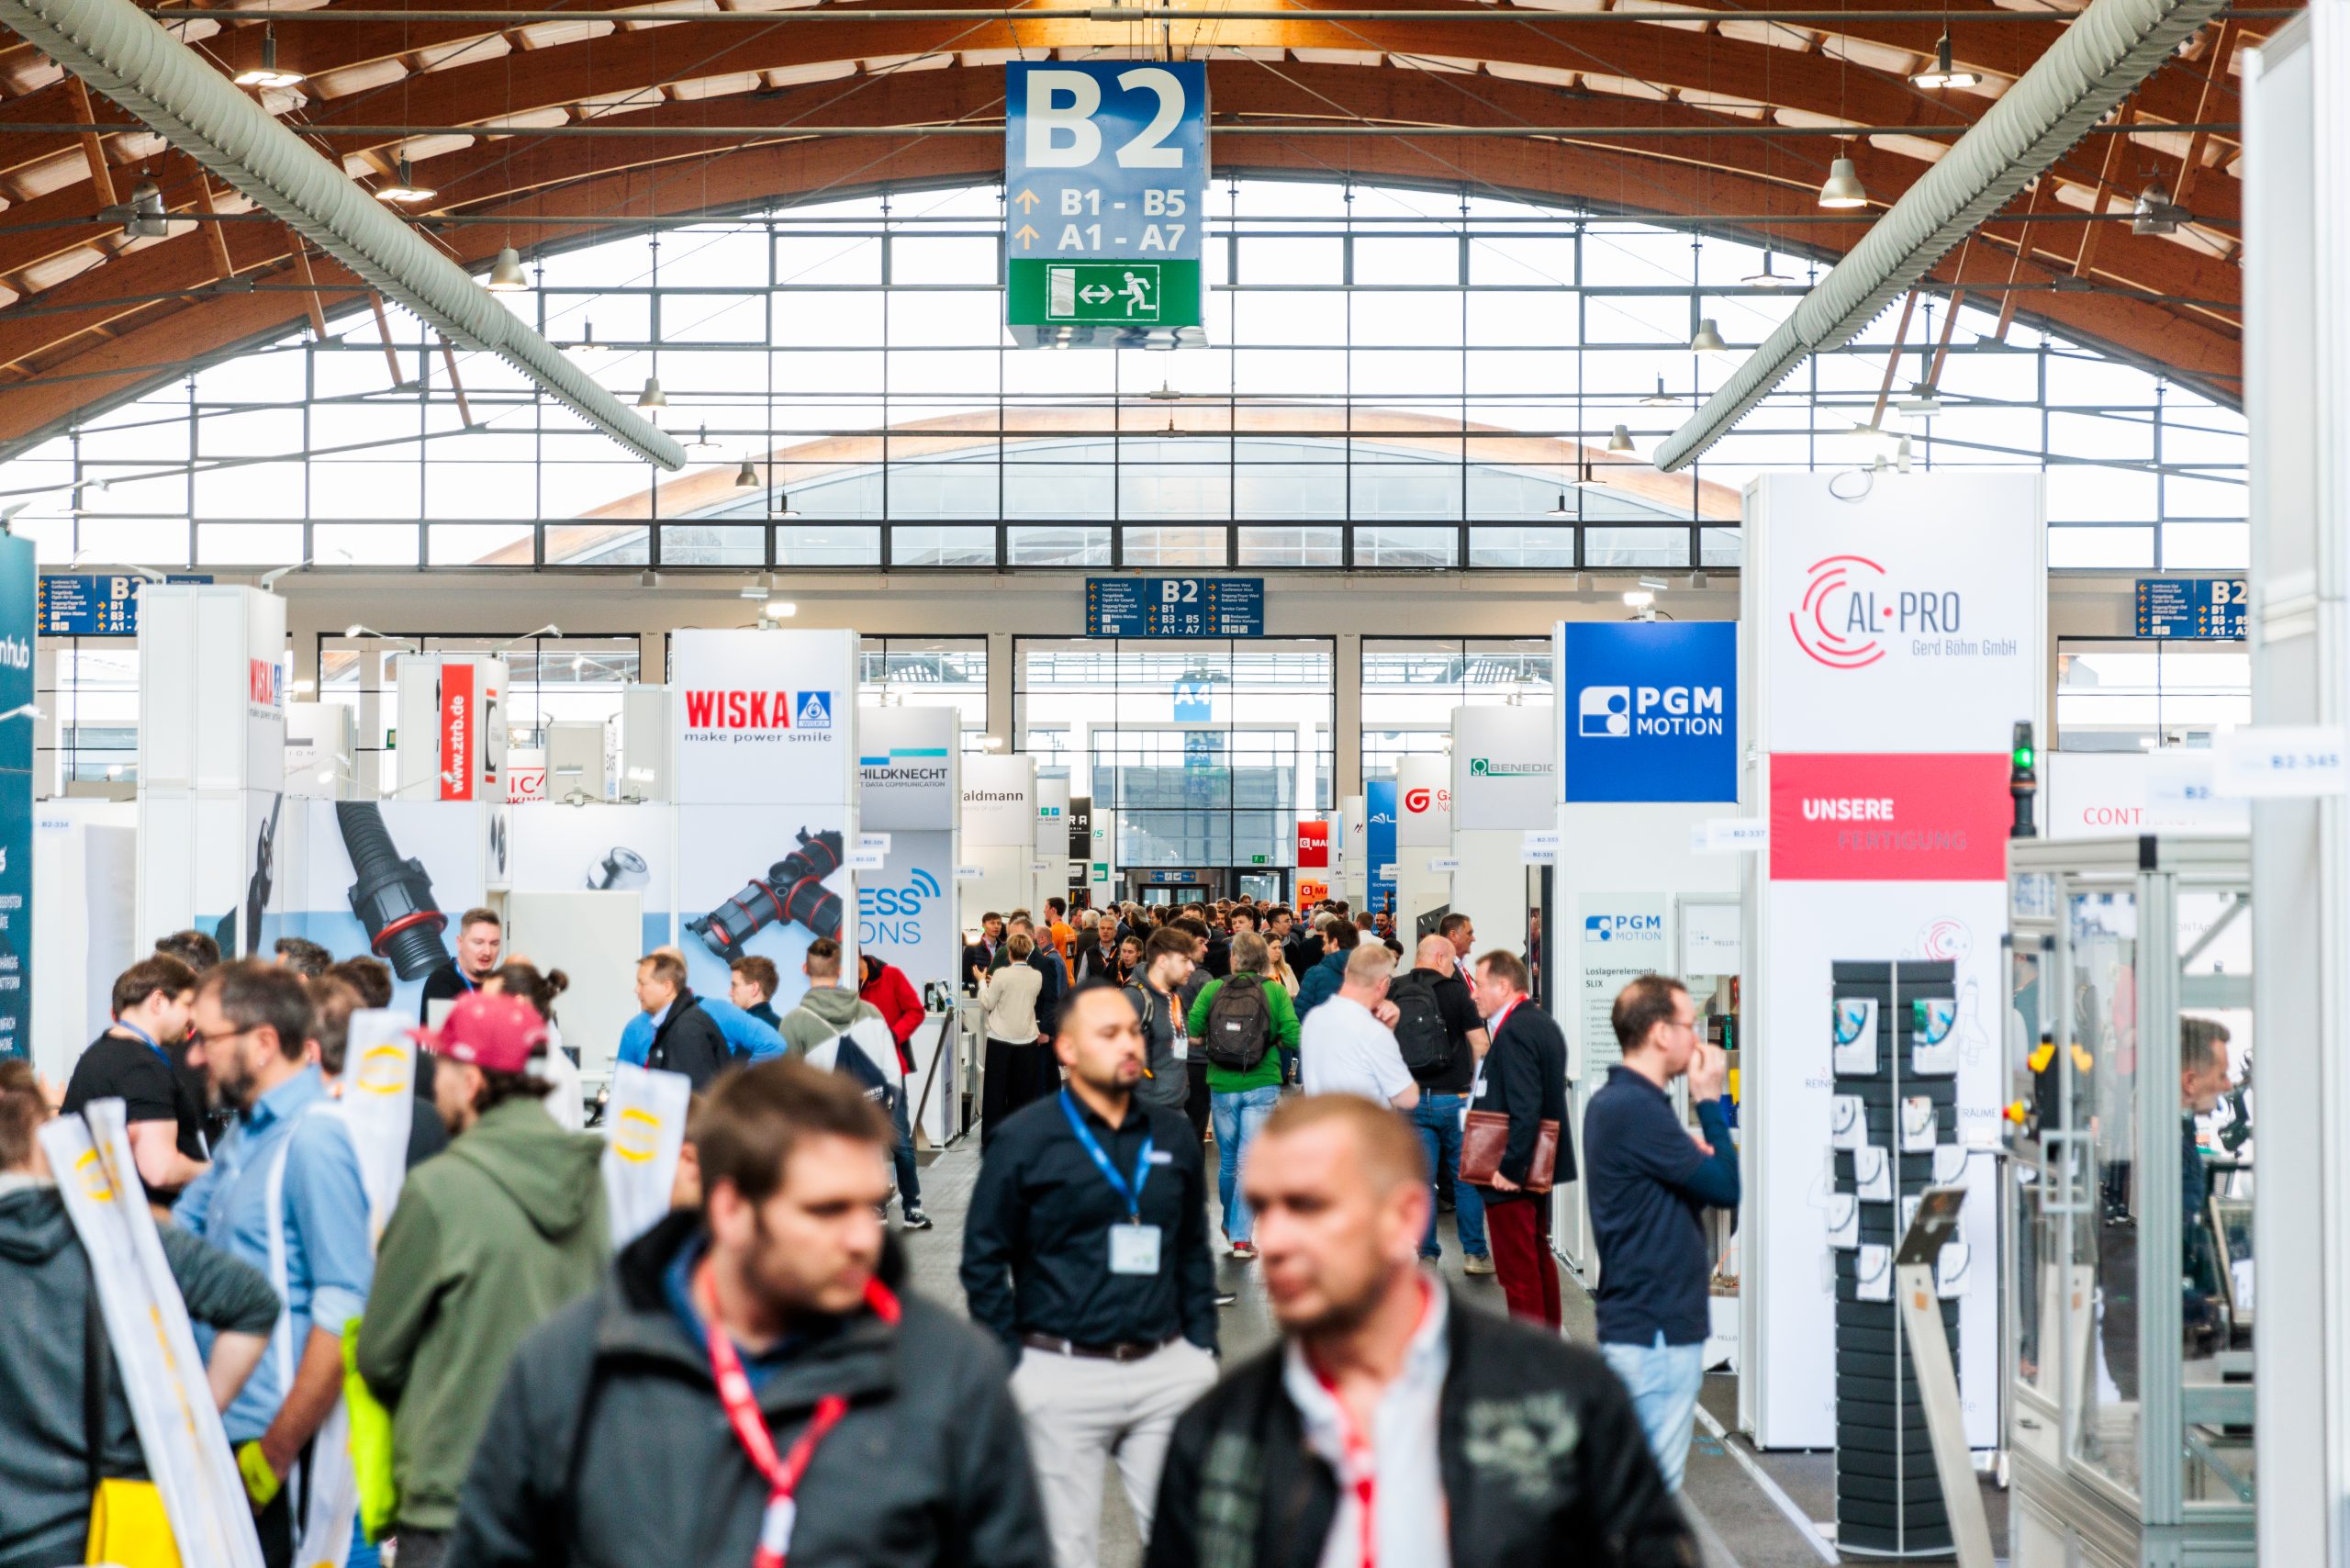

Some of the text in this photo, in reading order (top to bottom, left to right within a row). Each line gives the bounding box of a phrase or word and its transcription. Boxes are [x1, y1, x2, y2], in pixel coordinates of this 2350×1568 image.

[1025, 67, 1186, 169] B2
[1060, 188, 1101, 216] B1
[1144, 189, 1186, 217] B5
[1058, 223, 1102, 251] A1
[1138, 224, 1186, 252] A7
[1162, 579, 1199, 603] B2
[2211, 580, 2247, 604] B2
[109, 601, 124, 610] B1
[1161, 604, 1175, 613] B1
[2211, 605, 2225, 614] B1
[109, 611, 124, 621] B3
[1161, 614, 1175, 623] B3
[1185, 614, 1200, 623] B5
[2211, 615, 2226, 625] B3
[109, 622, 125, 631] A1
[1161, 625, 1175, 633] A1
[1185, 625, 1200, 633] A7
[2210, 625, 2226, 635] A1
[1912, 639, 2017, 655] Gerd Böhm GmbH
[250, 657, 274, 706] WISKA
[1174, 684, 1212, 705] A4
[1637, 686, 1723, 715] PGM
[686, 690, 791, 729] WISKA
[1637, 717, 1723, 735] MOTION
[450, 695, 464, 794] www.ztrb.de
[684, 732, 833, 744] make power smile
[962, 790, 1024, 801] aldmann
[1802, 798, 1895, 821] UNSERE
[1838, 830, 1967, 850] FERTIGUNG
[1616, 915, 1662, 929] PGM
[1616, 931, 1662, 941] MOTION
[1585, 980, 1604, 988] SLIX
